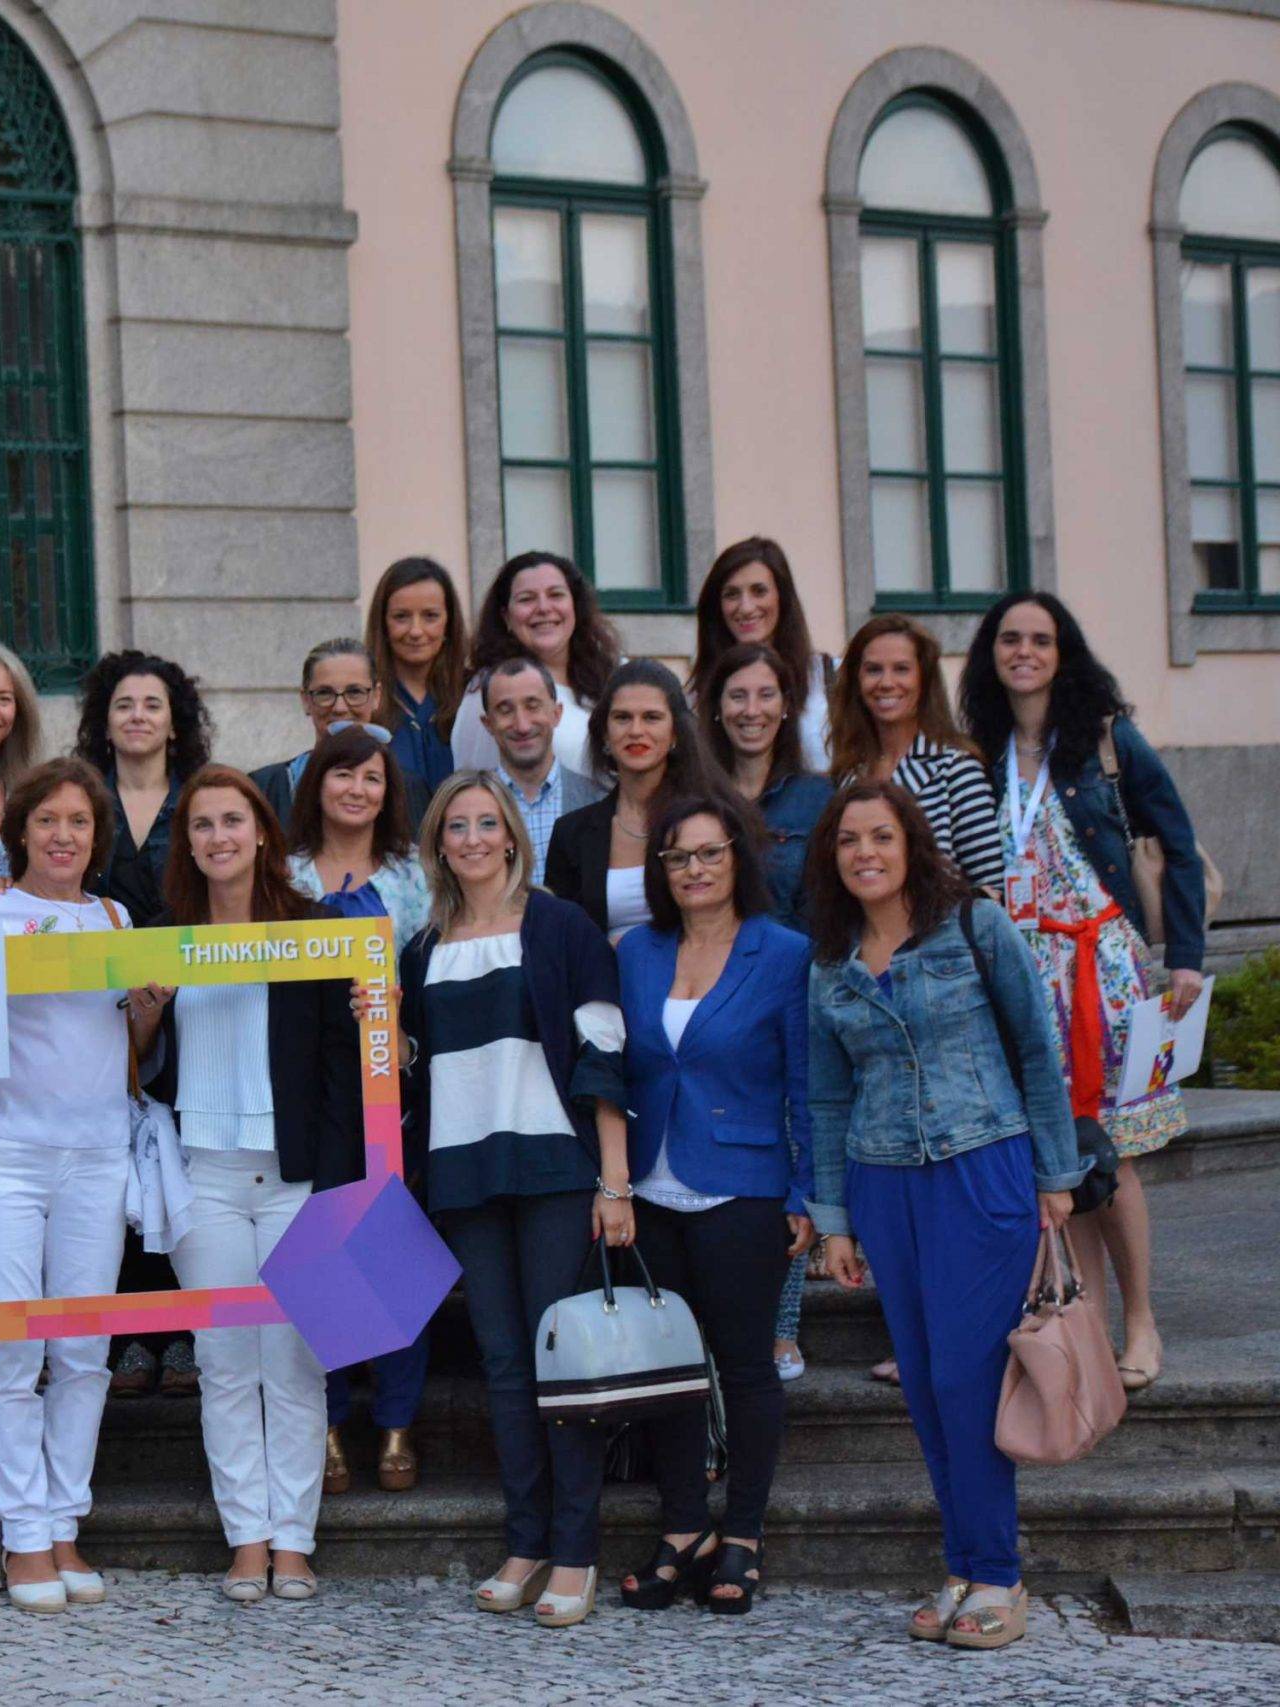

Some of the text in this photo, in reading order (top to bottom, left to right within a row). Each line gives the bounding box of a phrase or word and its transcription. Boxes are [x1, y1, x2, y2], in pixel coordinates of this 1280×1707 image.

[180, 936, 354, 965] THINKING OUT
[365, 935, 391, 1078] OF THE BOX
